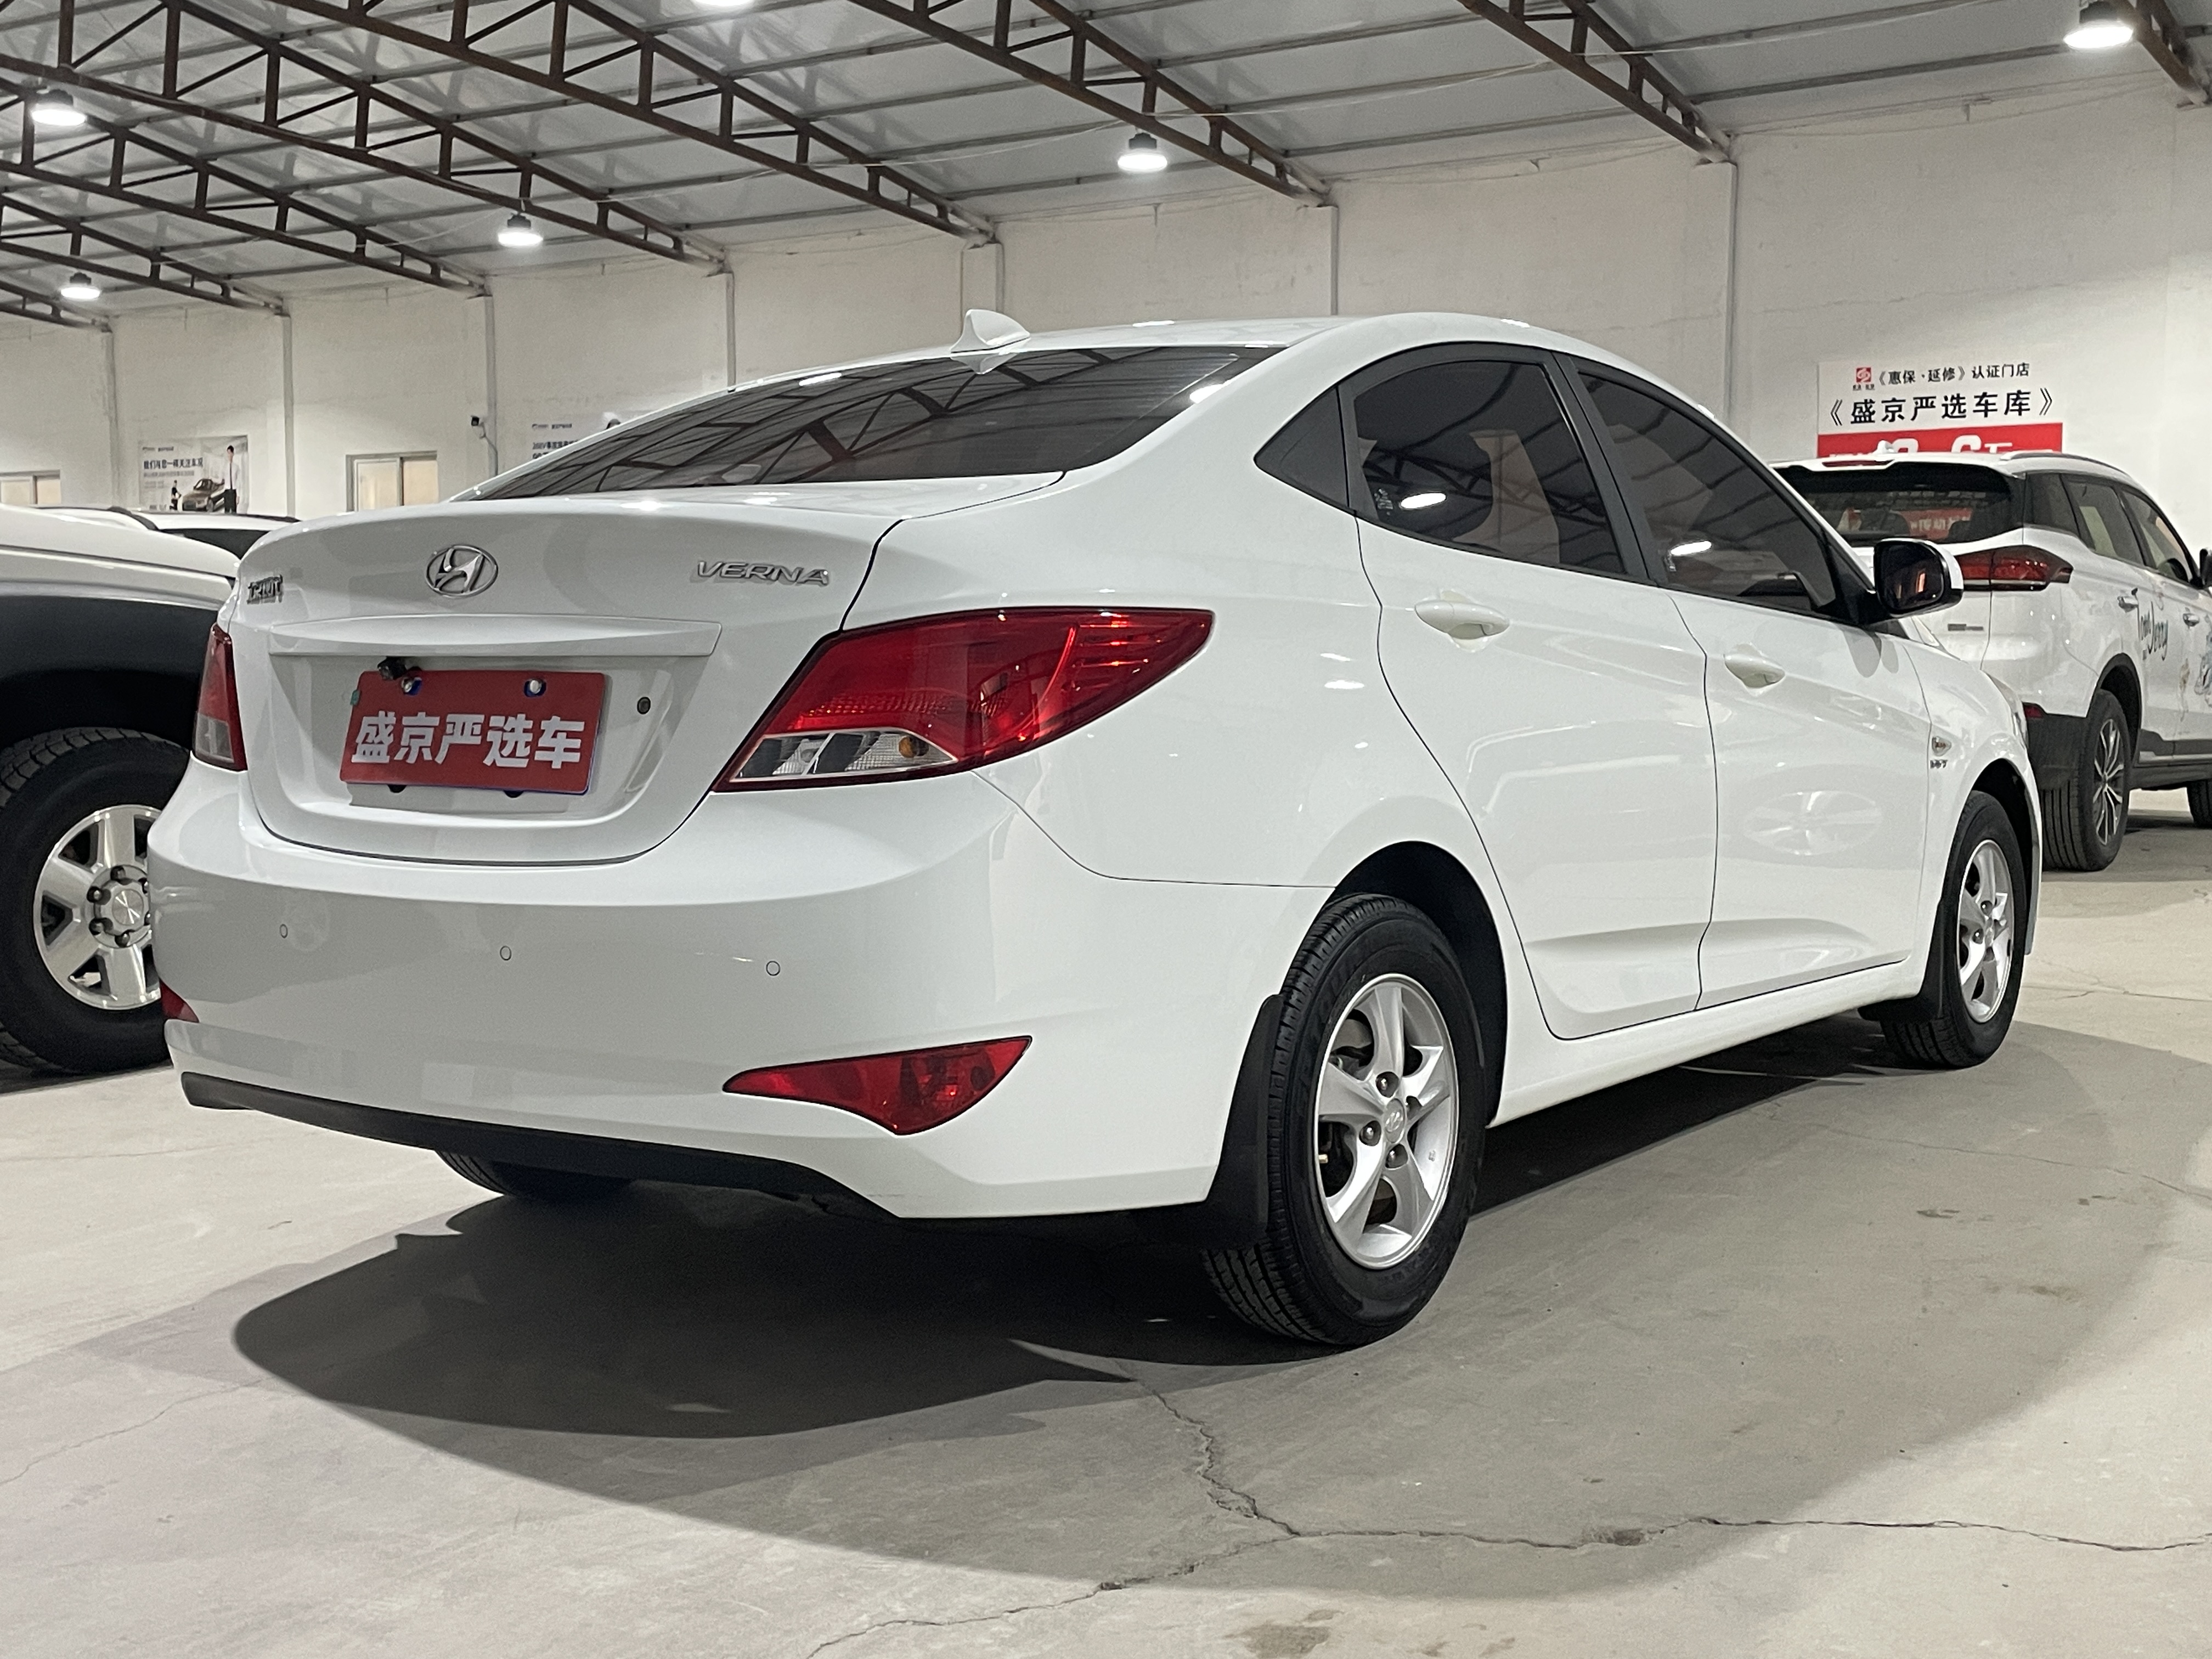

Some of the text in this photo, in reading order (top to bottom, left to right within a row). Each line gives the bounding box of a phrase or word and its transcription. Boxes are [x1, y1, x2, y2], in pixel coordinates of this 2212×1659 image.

[1830, 388, 2052, 426] 《盛京严选车库》
[697, 560, 830, 586] VERNA
[351, 711, 585, 769] 盛京严选车
